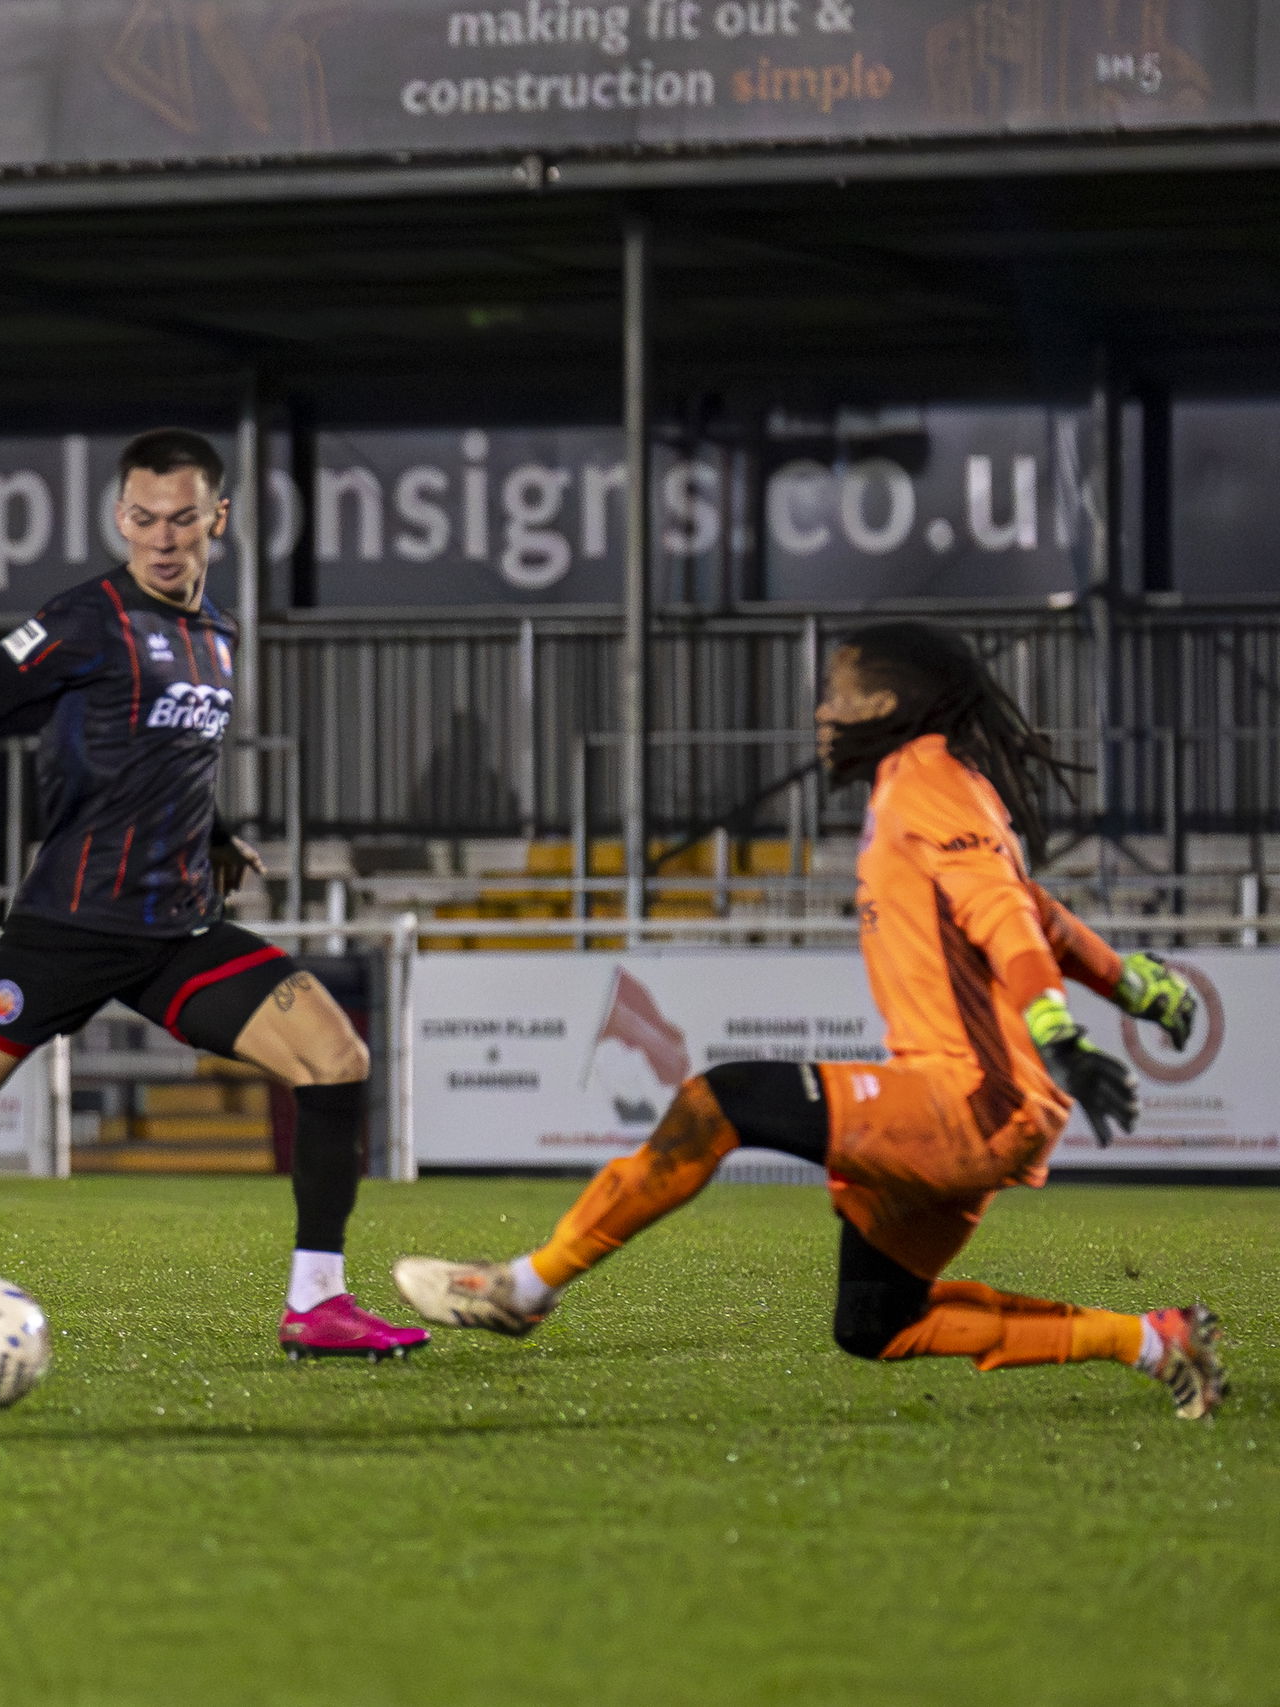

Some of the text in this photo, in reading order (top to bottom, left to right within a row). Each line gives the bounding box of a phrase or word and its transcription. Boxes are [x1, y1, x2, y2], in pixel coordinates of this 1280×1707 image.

[447, 0, 629, 55] making
[714, 0, 800, 38] out
[816, 0, 855, 33] &
[400, 51, 894, 115] construction simple
